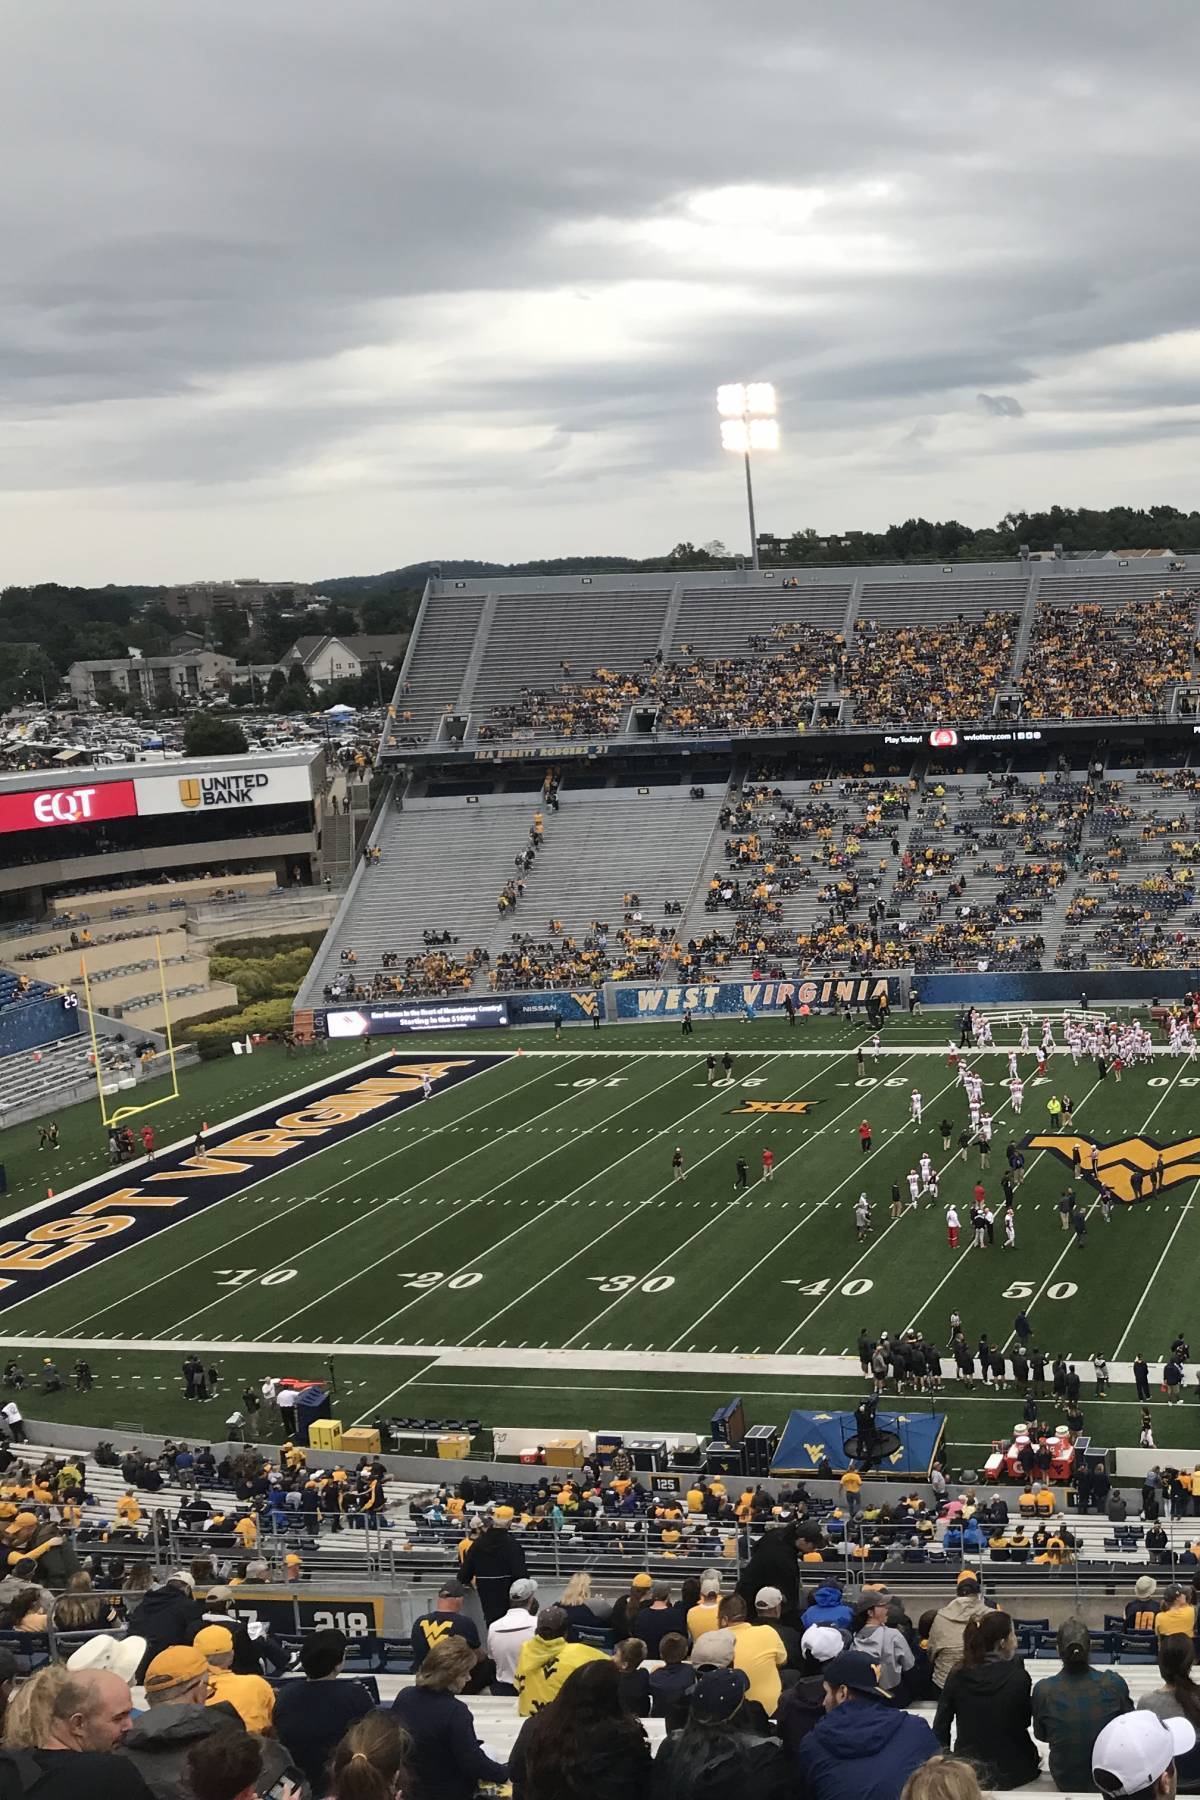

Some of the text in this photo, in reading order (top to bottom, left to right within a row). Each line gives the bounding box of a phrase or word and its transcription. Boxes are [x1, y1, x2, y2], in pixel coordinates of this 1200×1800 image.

[884, 735, 922, 744] Play Today!
[963, 733, 1011, 742] wvlottery.com
[201, 774, 269, 792] UNITED
[33, 789, 96, 822] EQT
[202, 788, 253, 806] BANK
[64, 994, 78, 1009] 25
[637, 979, 889, 1011] WEST VIRGINIA
[522, 1004, 557, 1013] NISSAN
[572, 1077, 629, 1088] 10
[852, 1077, 909, 1088] 30
[1146, 1077, 1200, 1088] 50
[141, 1059, 477, 1182] VIRGINIA
[0, 1187, 189, 1291] EST
[217, 1269, 298, 1286] 10
[404, 1271, 484, 1289] 20
[598, 1275, 676, 1292] 30
[798, 1278, 874, 1296] 40
[1001, 1281, 1079, 1300] 50
[657, 1479, 675, 1490] 125
[313, 1611, 368, 1637] 218
[1135, 1611, 1154, 1630] 10
